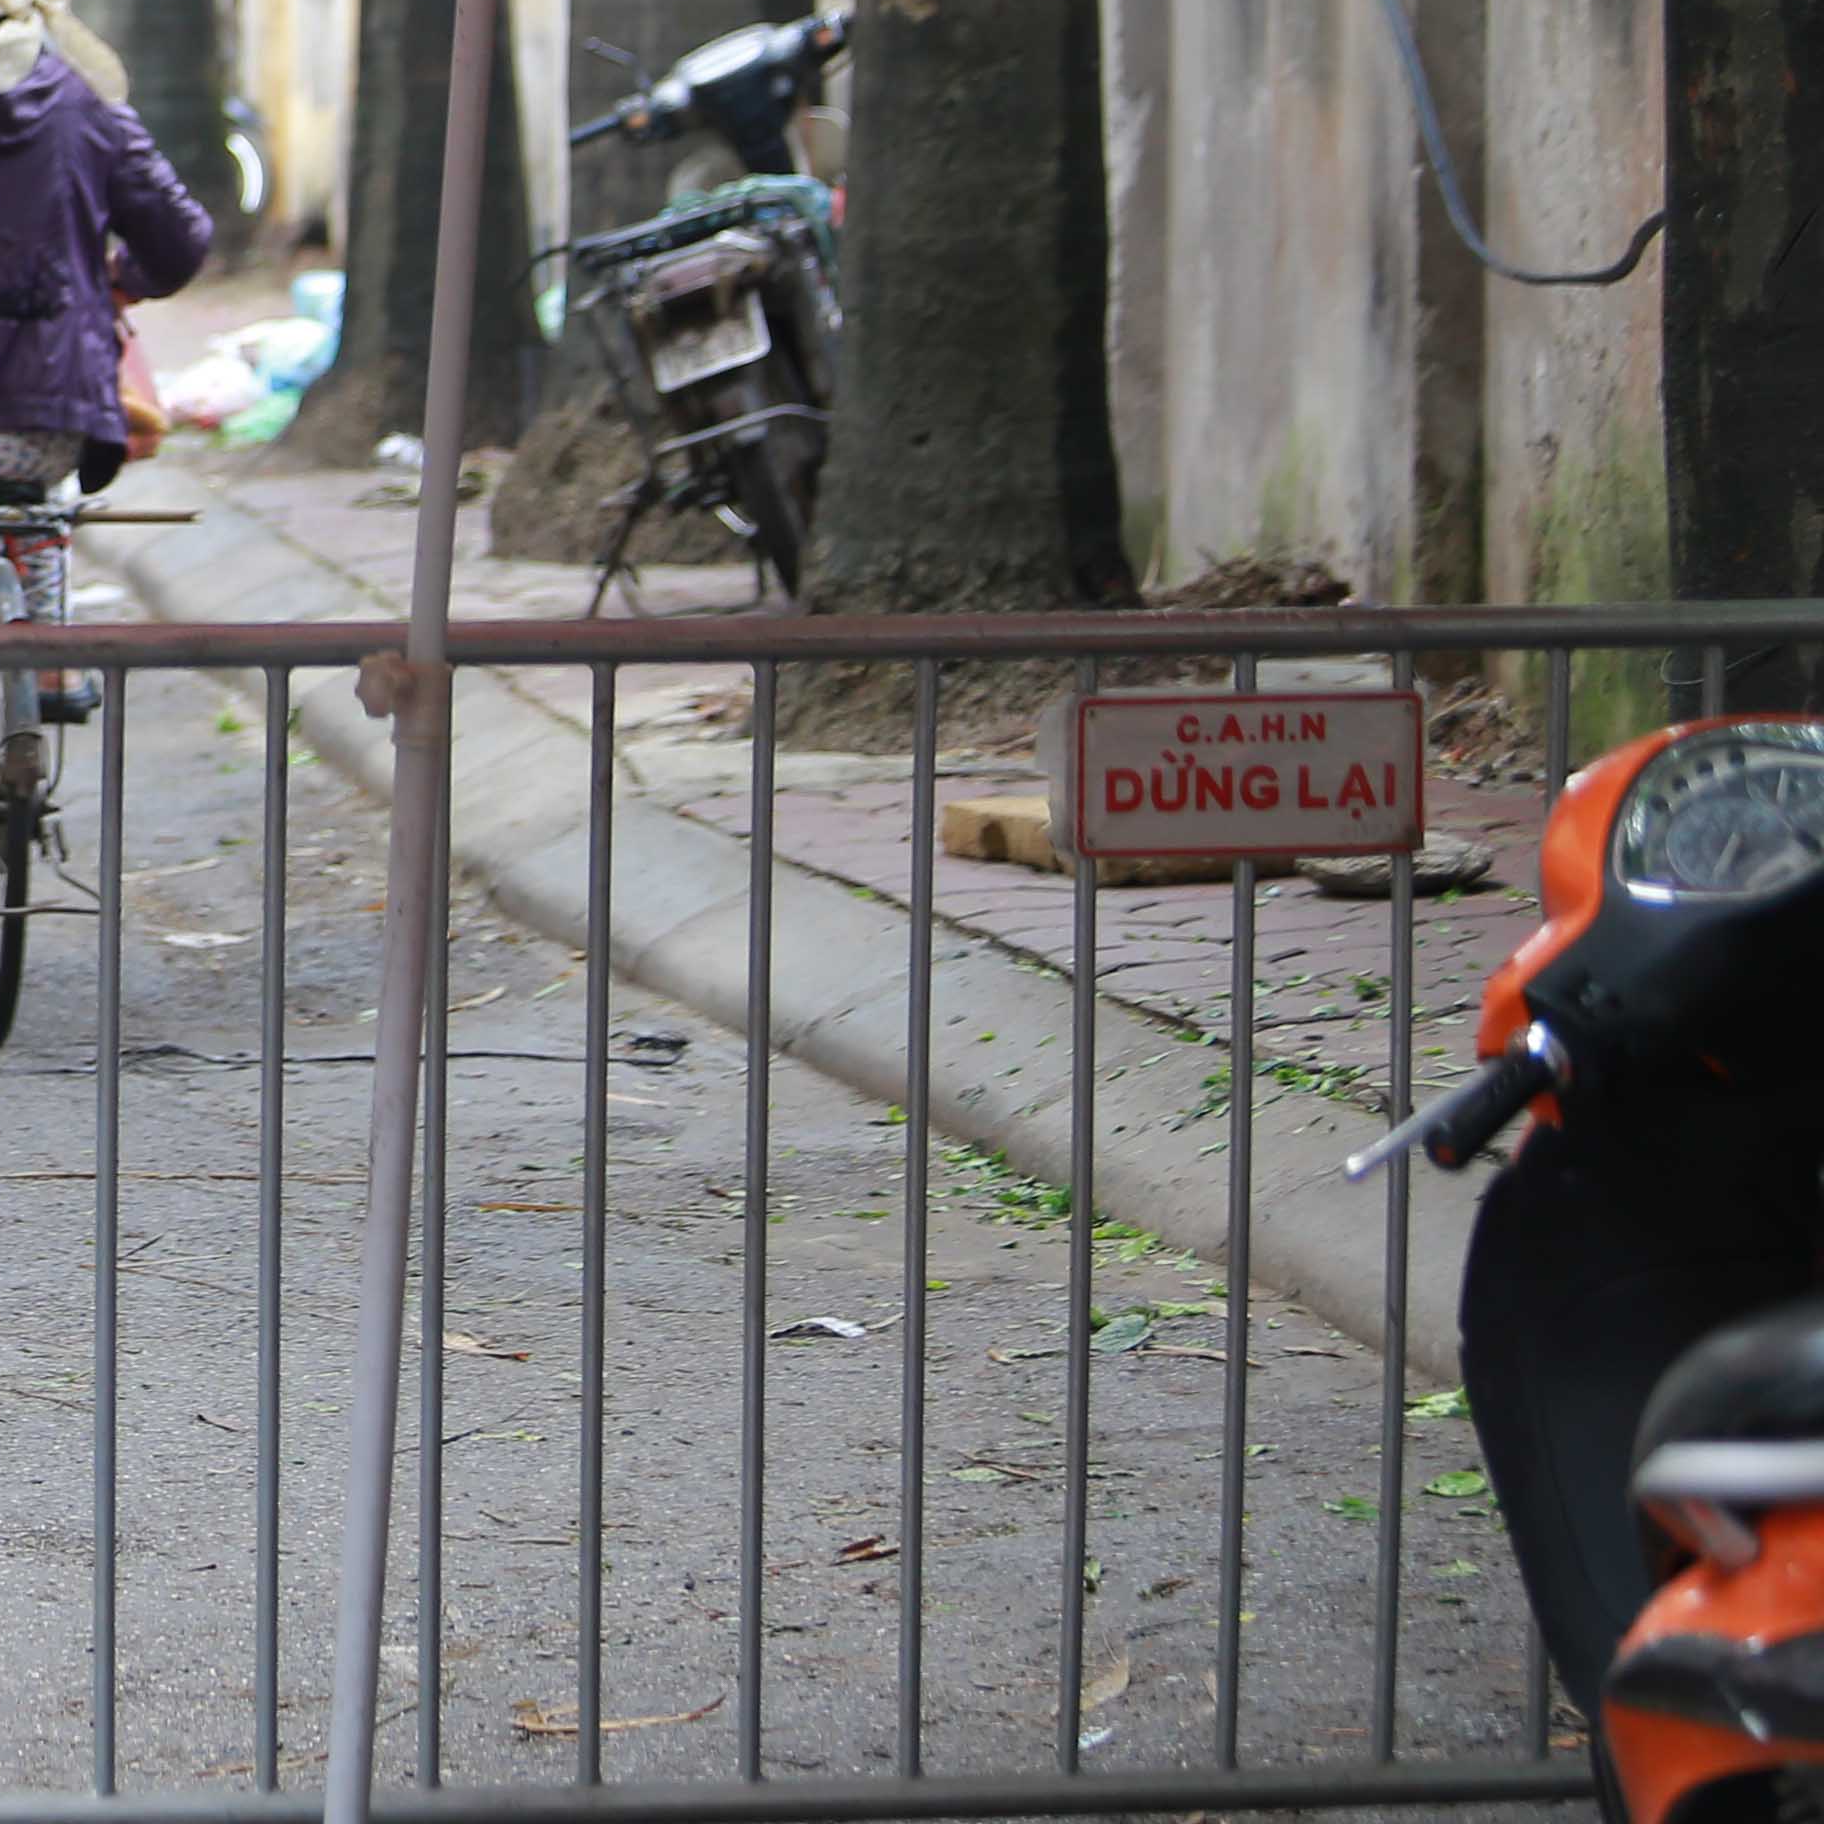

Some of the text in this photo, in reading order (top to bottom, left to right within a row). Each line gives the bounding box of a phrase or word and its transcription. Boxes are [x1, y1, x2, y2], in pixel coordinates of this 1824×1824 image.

[1175, 712, 1327, 744] C.A.H.N
[1104, 749, 1396, 820] DỪNG LẠI
